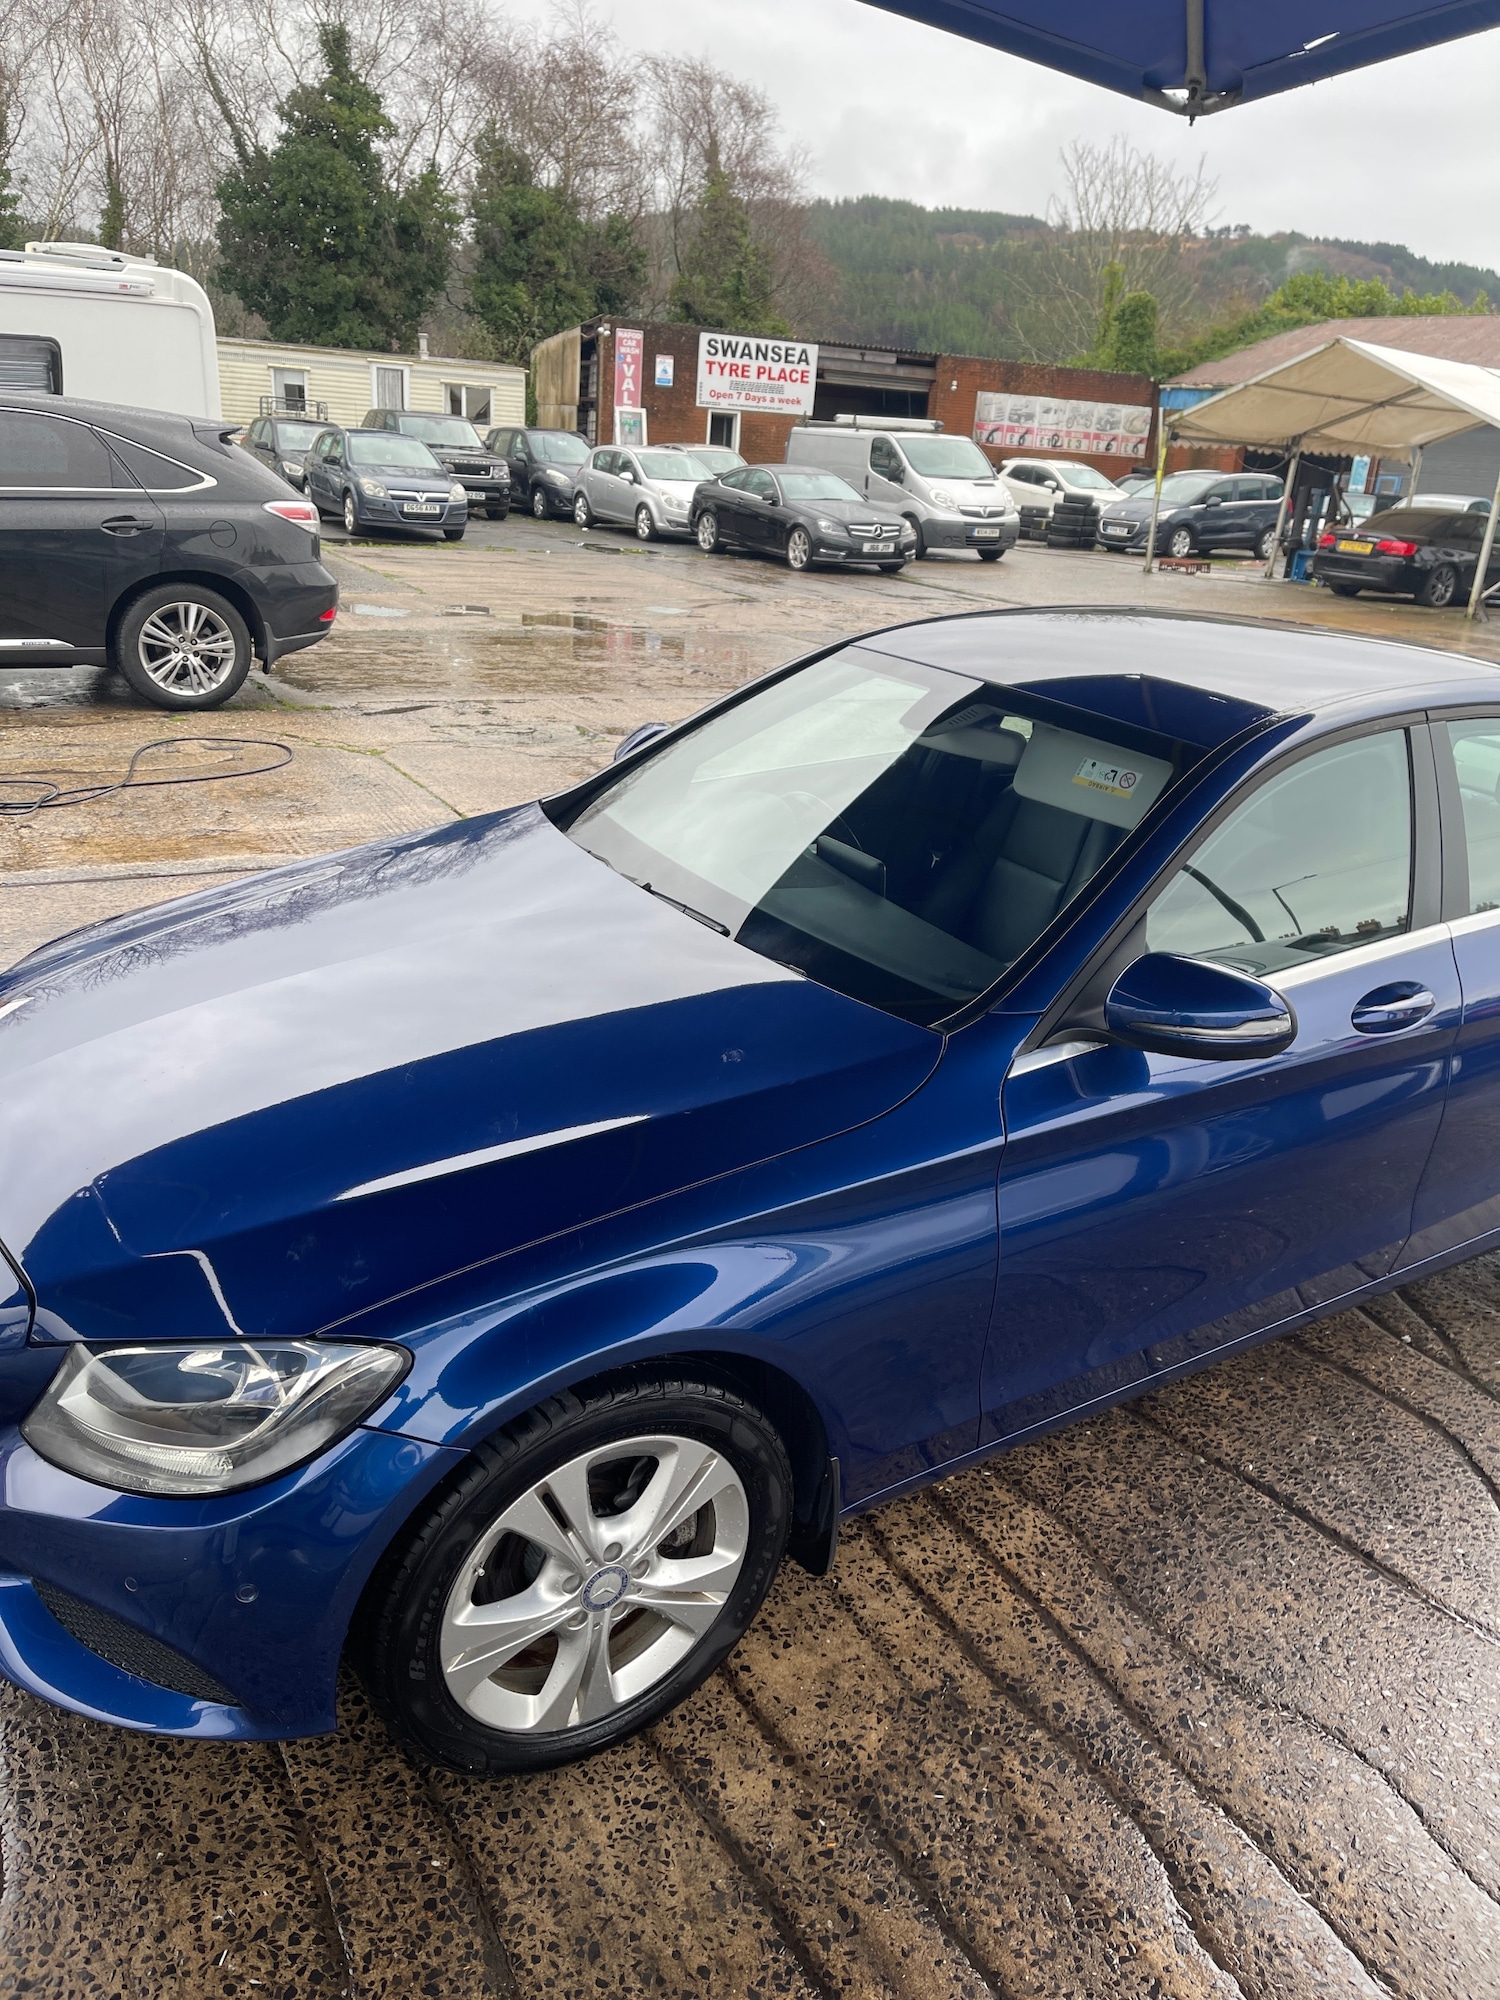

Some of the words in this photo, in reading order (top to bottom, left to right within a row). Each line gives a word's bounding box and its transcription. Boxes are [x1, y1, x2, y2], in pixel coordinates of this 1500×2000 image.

[622, 338, 637, 346] CAR
[706, 338, 811, 366] SWANSEA
[705, 360, 751, 378] TYRE
[757, 365, 811, 384] PLACE
[709, 389, 734, 400] Open
[736, 392, 742, 400] 7
[744, 392, 768, 403] Days
[778, 397, 802, 405] week
